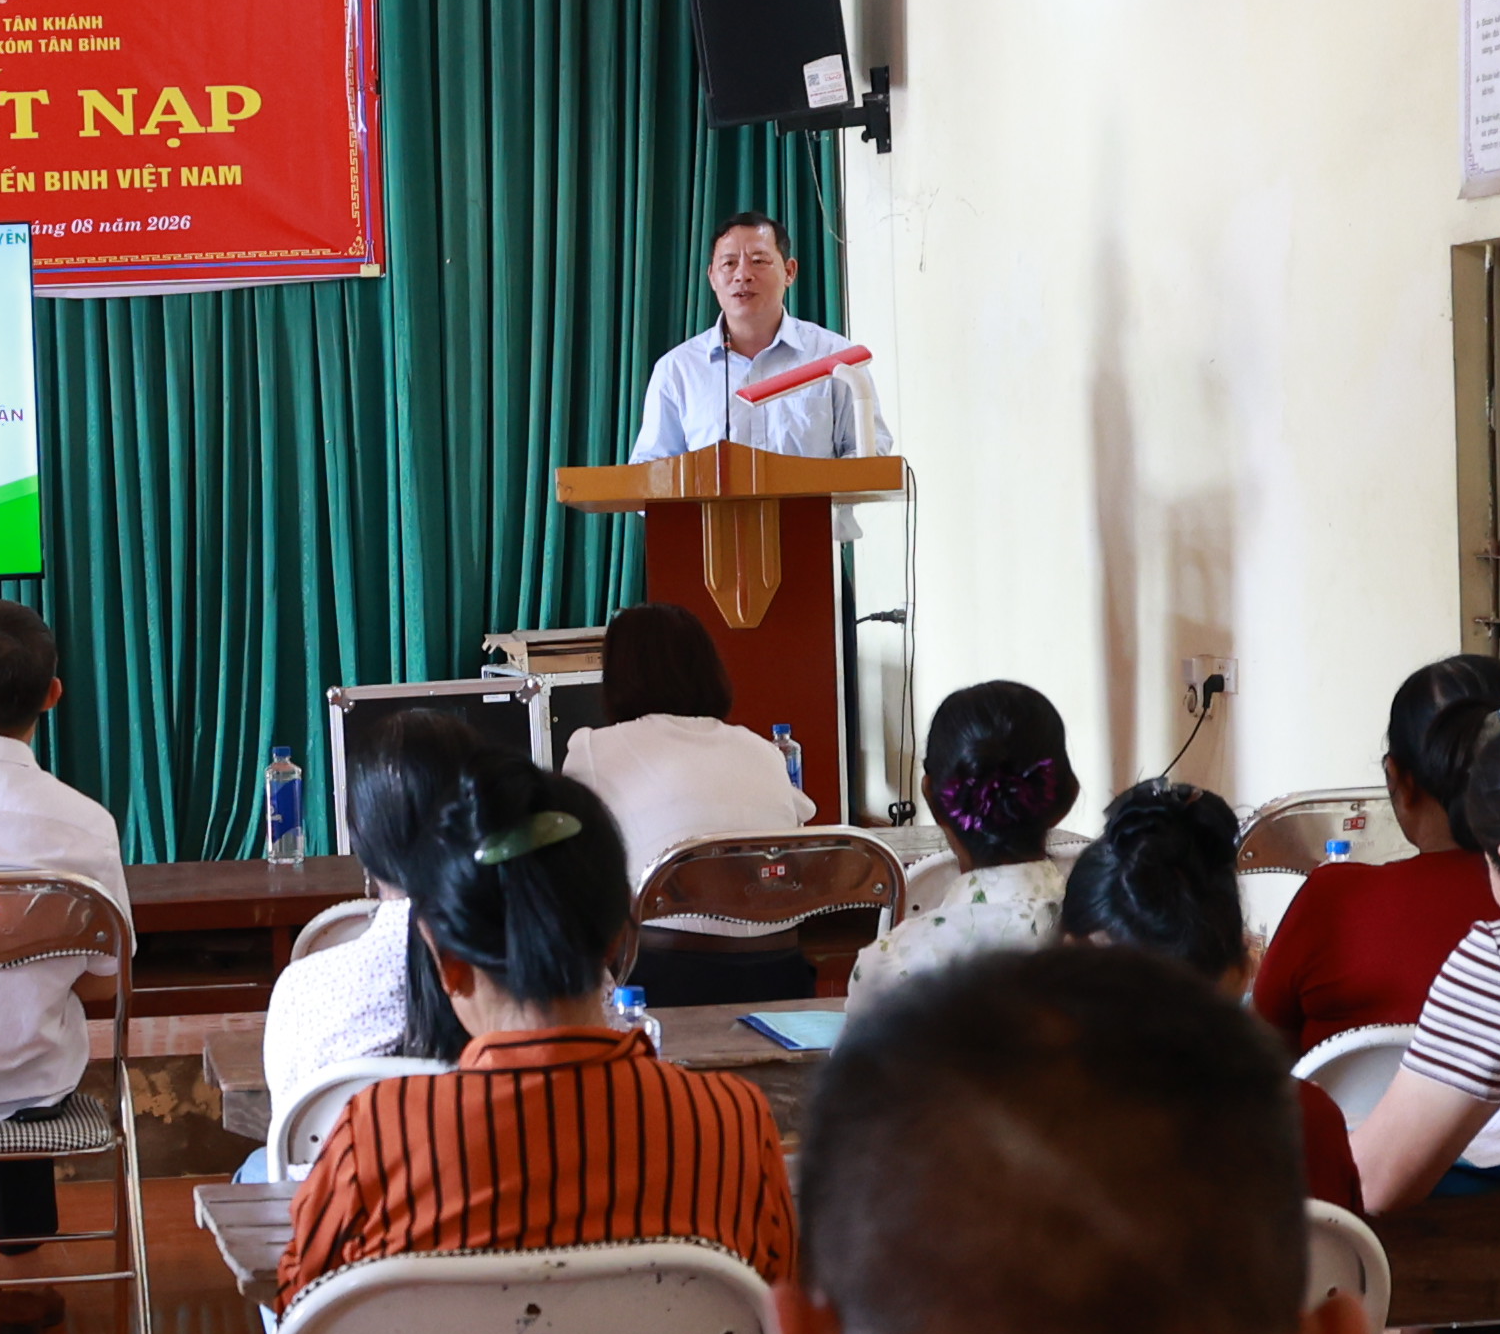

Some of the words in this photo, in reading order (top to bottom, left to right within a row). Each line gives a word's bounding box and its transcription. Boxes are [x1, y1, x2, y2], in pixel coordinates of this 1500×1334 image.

[3, 15, 37, 31] TÂN
[43, 14, 102, 30] KHÁNH
[38, 36, 72, 52] TÂN
[79, 35, 120, 51] BÌNH
[78, 85, 261, 147] NẠP
[45, 170, 108, 191] BINH
[116, 164, 171, 192] VIỆT
[181, 165, 242, 186] NAM
[32, 217, 66, 238] áng
[72, 219, 92, 233] 08
[100, 219, 140, 232] năm
[147, 216, 190, 230] 2026
